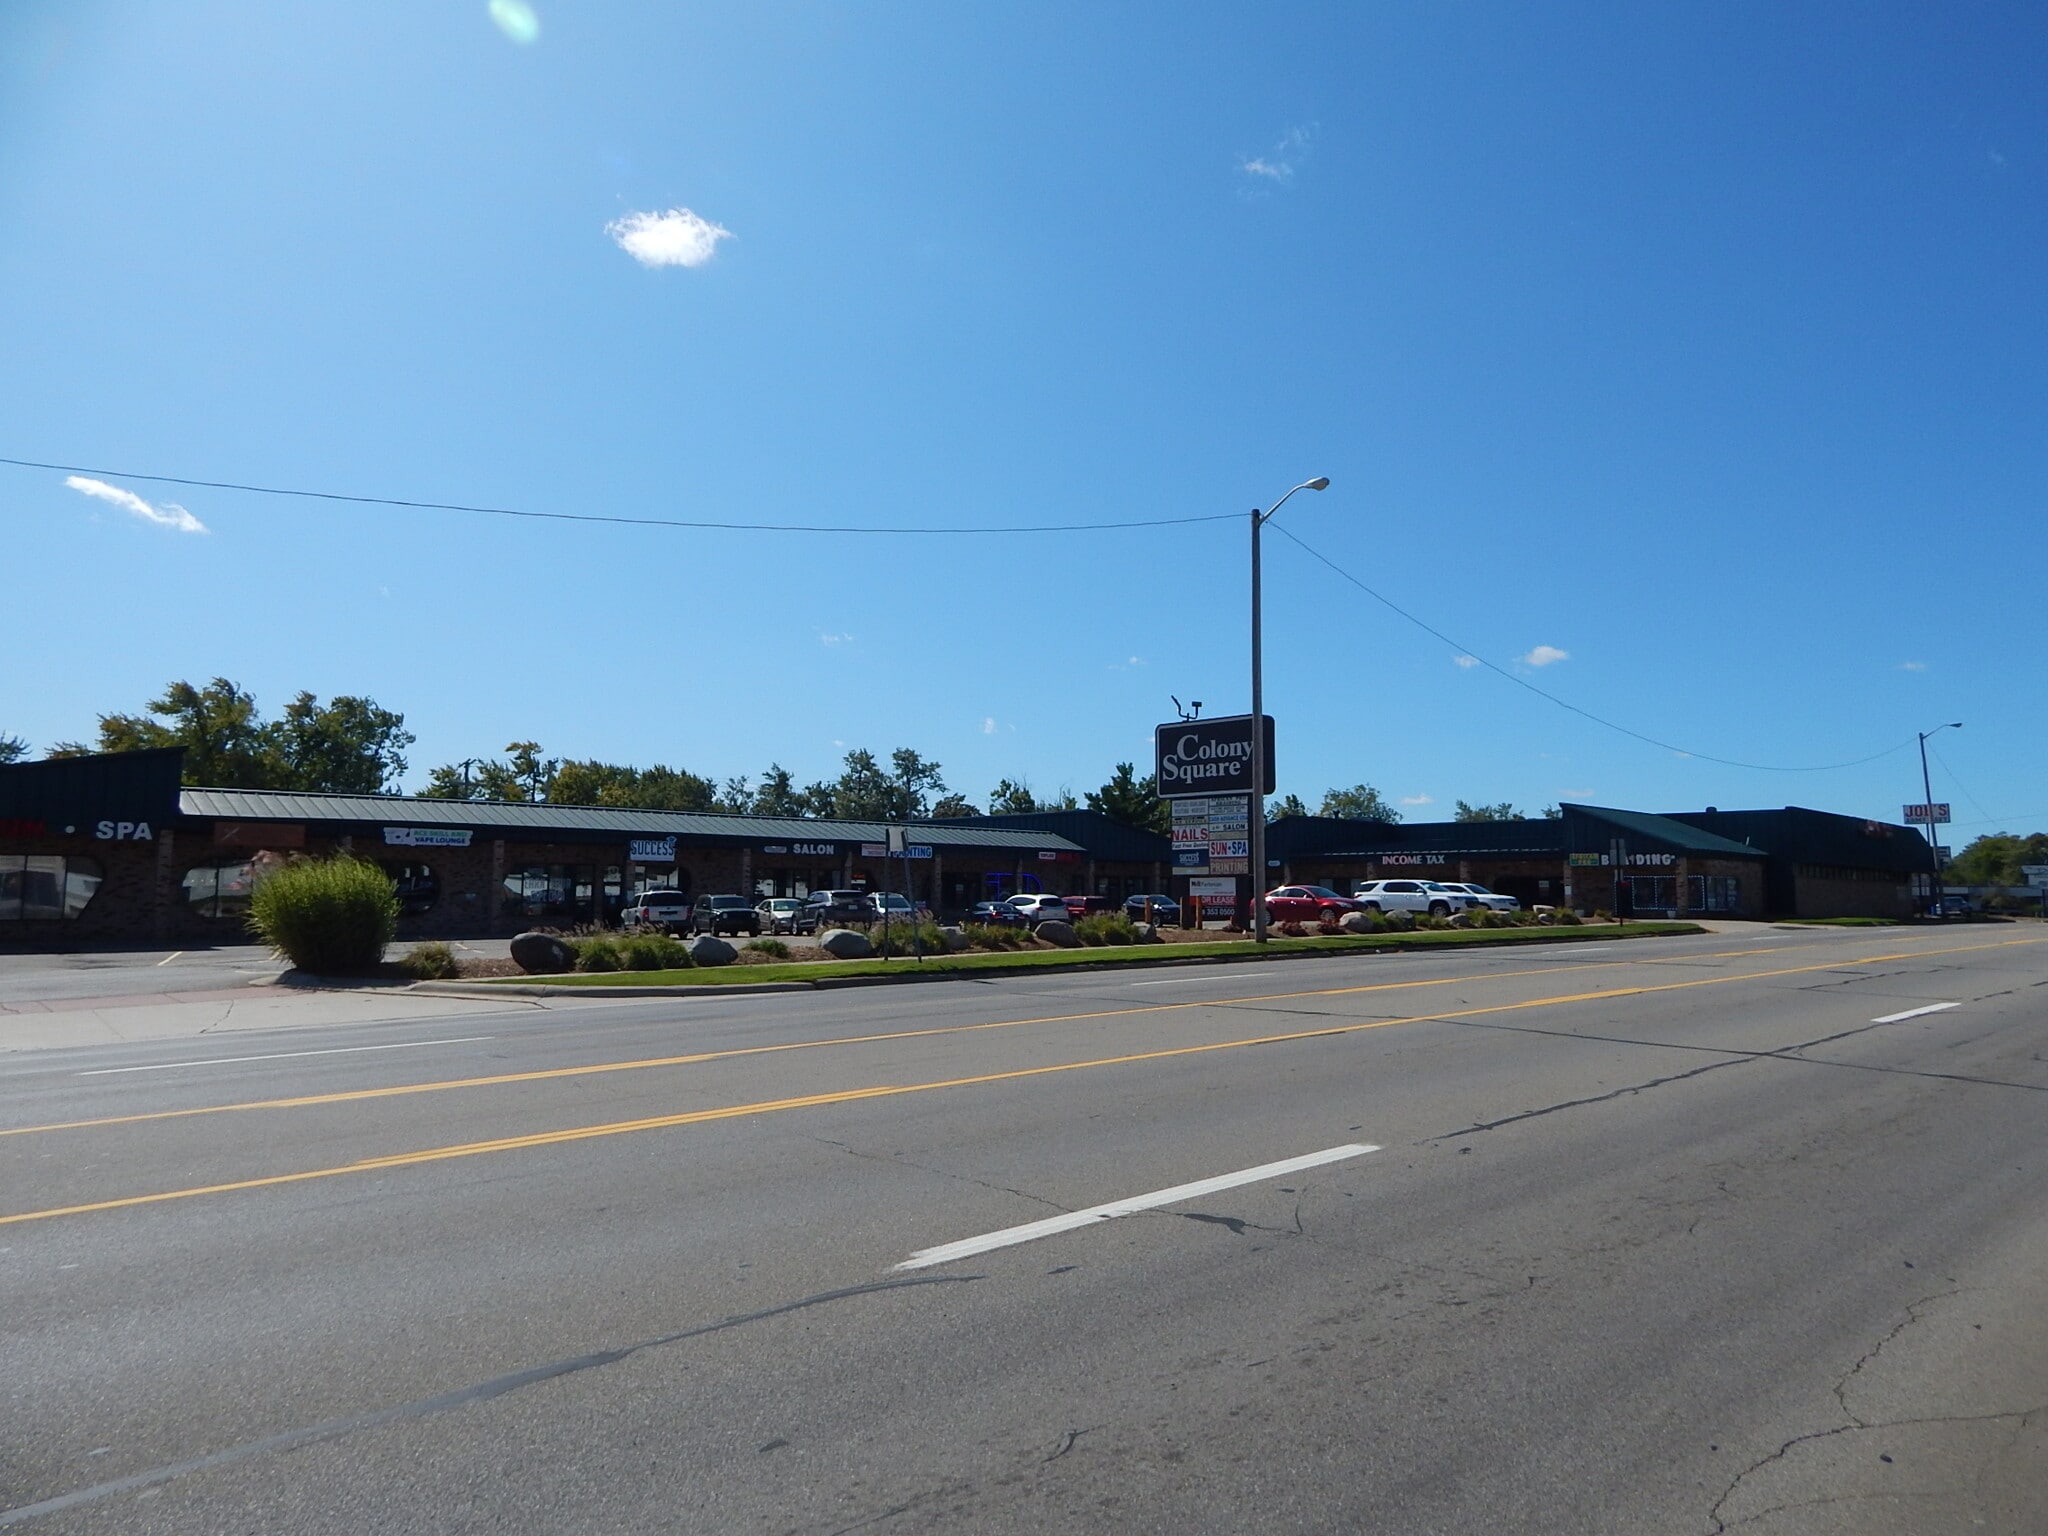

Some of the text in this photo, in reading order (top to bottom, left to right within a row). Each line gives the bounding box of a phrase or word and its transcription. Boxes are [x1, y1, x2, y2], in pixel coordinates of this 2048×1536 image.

[1176, 734, 1254, 761] Colony
[1162, 754, 1241, 784] Square
[95, 820, 153, 841] SPA
[1171, 828, 1208, 840] NAILS
[631, 840, 674, 856] SUCCESS
[793, 843, 834, 855] SALON
[1210, 841, 1247, 855] SUN SPA
[1382, 855, 1445, 864] INCOME TAX
[1601, 854, 1671, 865] BIDING
[1210, 862, 1248, 874] PRINTING
[1212, 896, 1235, 904] LEASE
